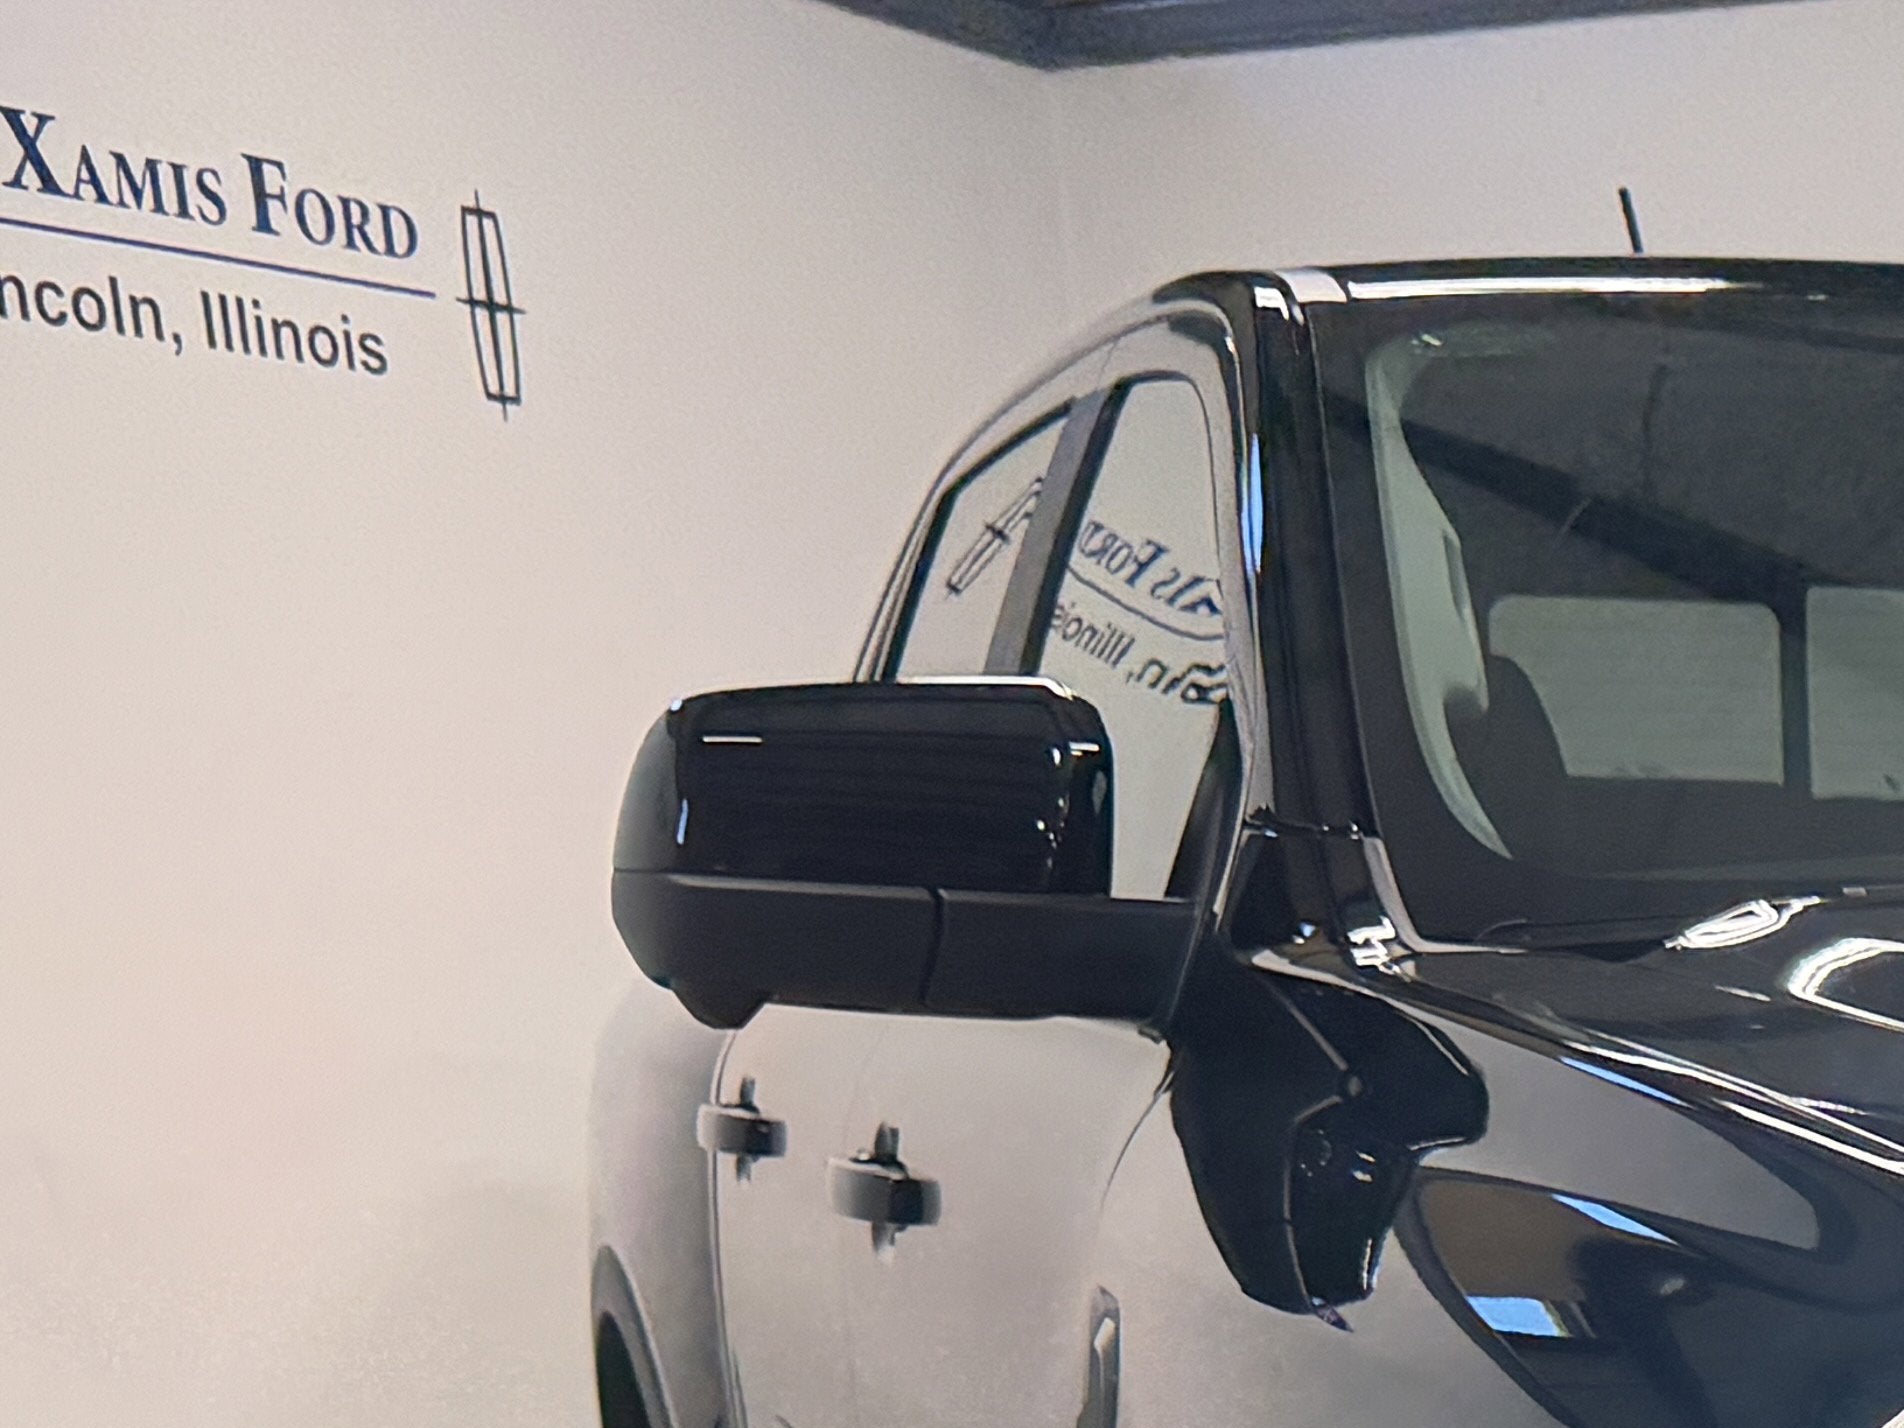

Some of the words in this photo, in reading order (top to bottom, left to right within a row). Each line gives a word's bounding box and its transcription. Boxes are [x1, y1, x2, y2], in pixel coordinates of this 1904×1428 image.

[0, 105, 228, 226] XAMIS
[240, 152, 419, 259] FORD
[0, 275, 183, 356] ncoln,
[200, 290, 389, 376] Illinois
